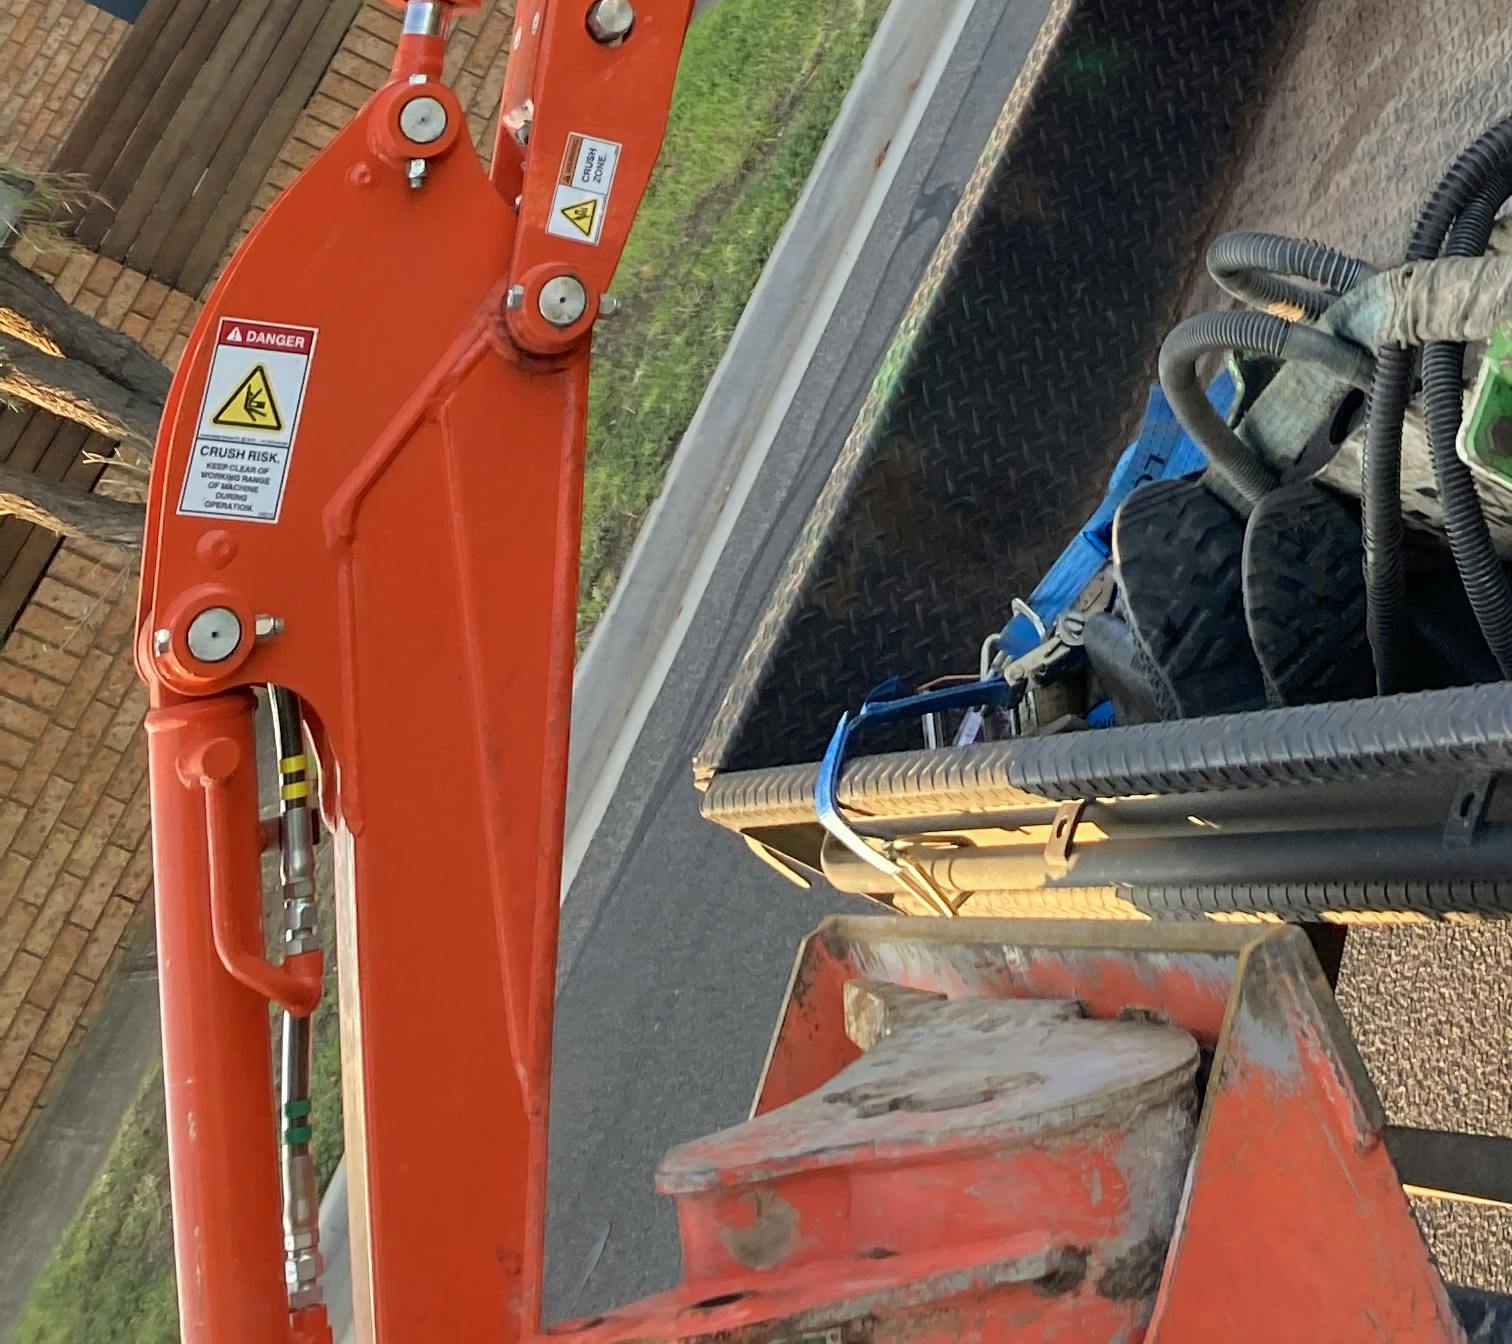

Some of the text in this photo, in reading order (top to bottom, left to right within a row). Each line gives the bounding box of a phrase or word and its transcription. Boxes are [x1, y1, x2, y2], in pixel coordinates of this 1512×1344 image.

[581, 147, 597, 183] CRUSH
[246, 330, 305, 349] DANGER
[200, 445, 246, 460] CRUSH
[206, 462, 228, 470] KEEP
[229, 464, 256, 474] CLEAR
[201, 471, 270, 485] WORKING RANGE
[208, 481, 259, 493] OF MACHINE
[215, 492, 247, 502] DURING
